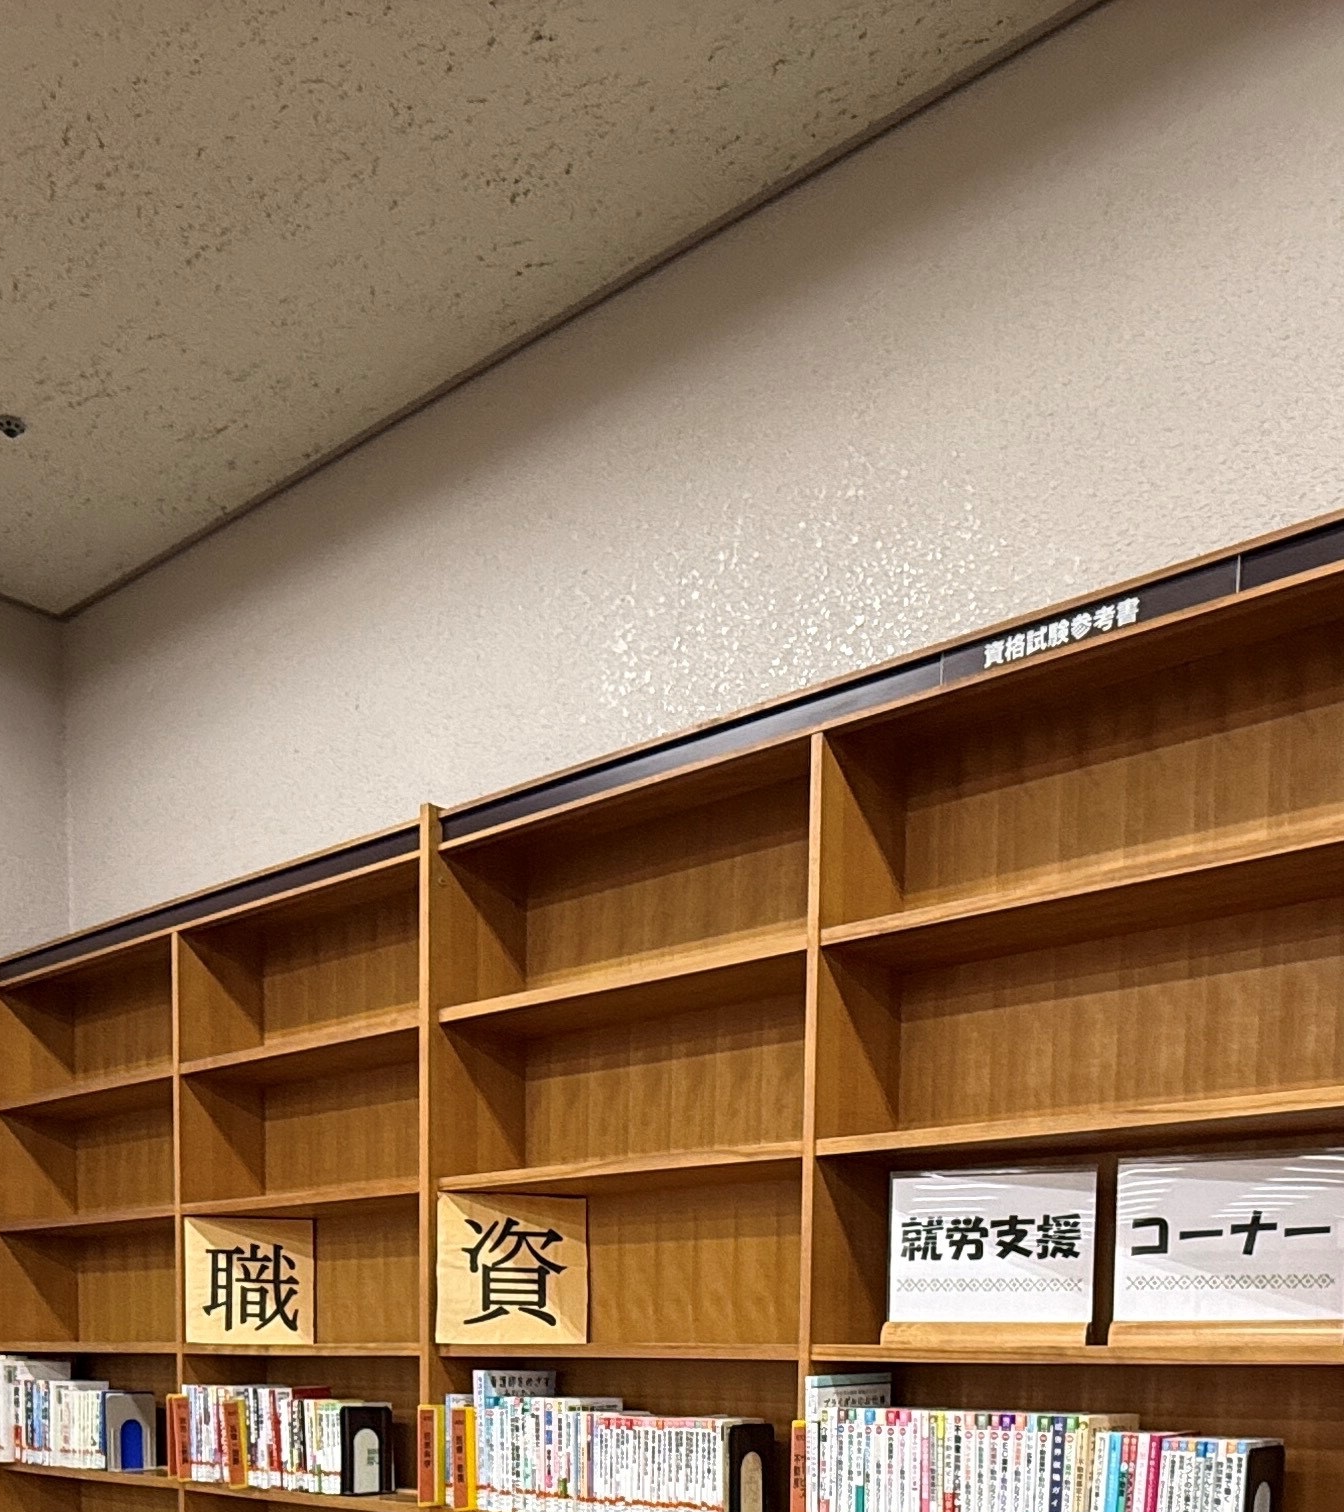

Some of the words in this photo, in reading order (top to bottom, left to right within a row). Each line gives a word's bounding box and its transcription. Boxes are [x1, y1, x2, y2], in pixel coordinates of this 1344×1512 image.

[984, 597, 1140, 668] 資格試験参考書
[462, 1216, 568, 1326] 資
[900, 1213, 1082, 1261] 就労支援
[1130, 1209, 1331, 1257] コーナー
[202, 1243, 300, 1332] 職
